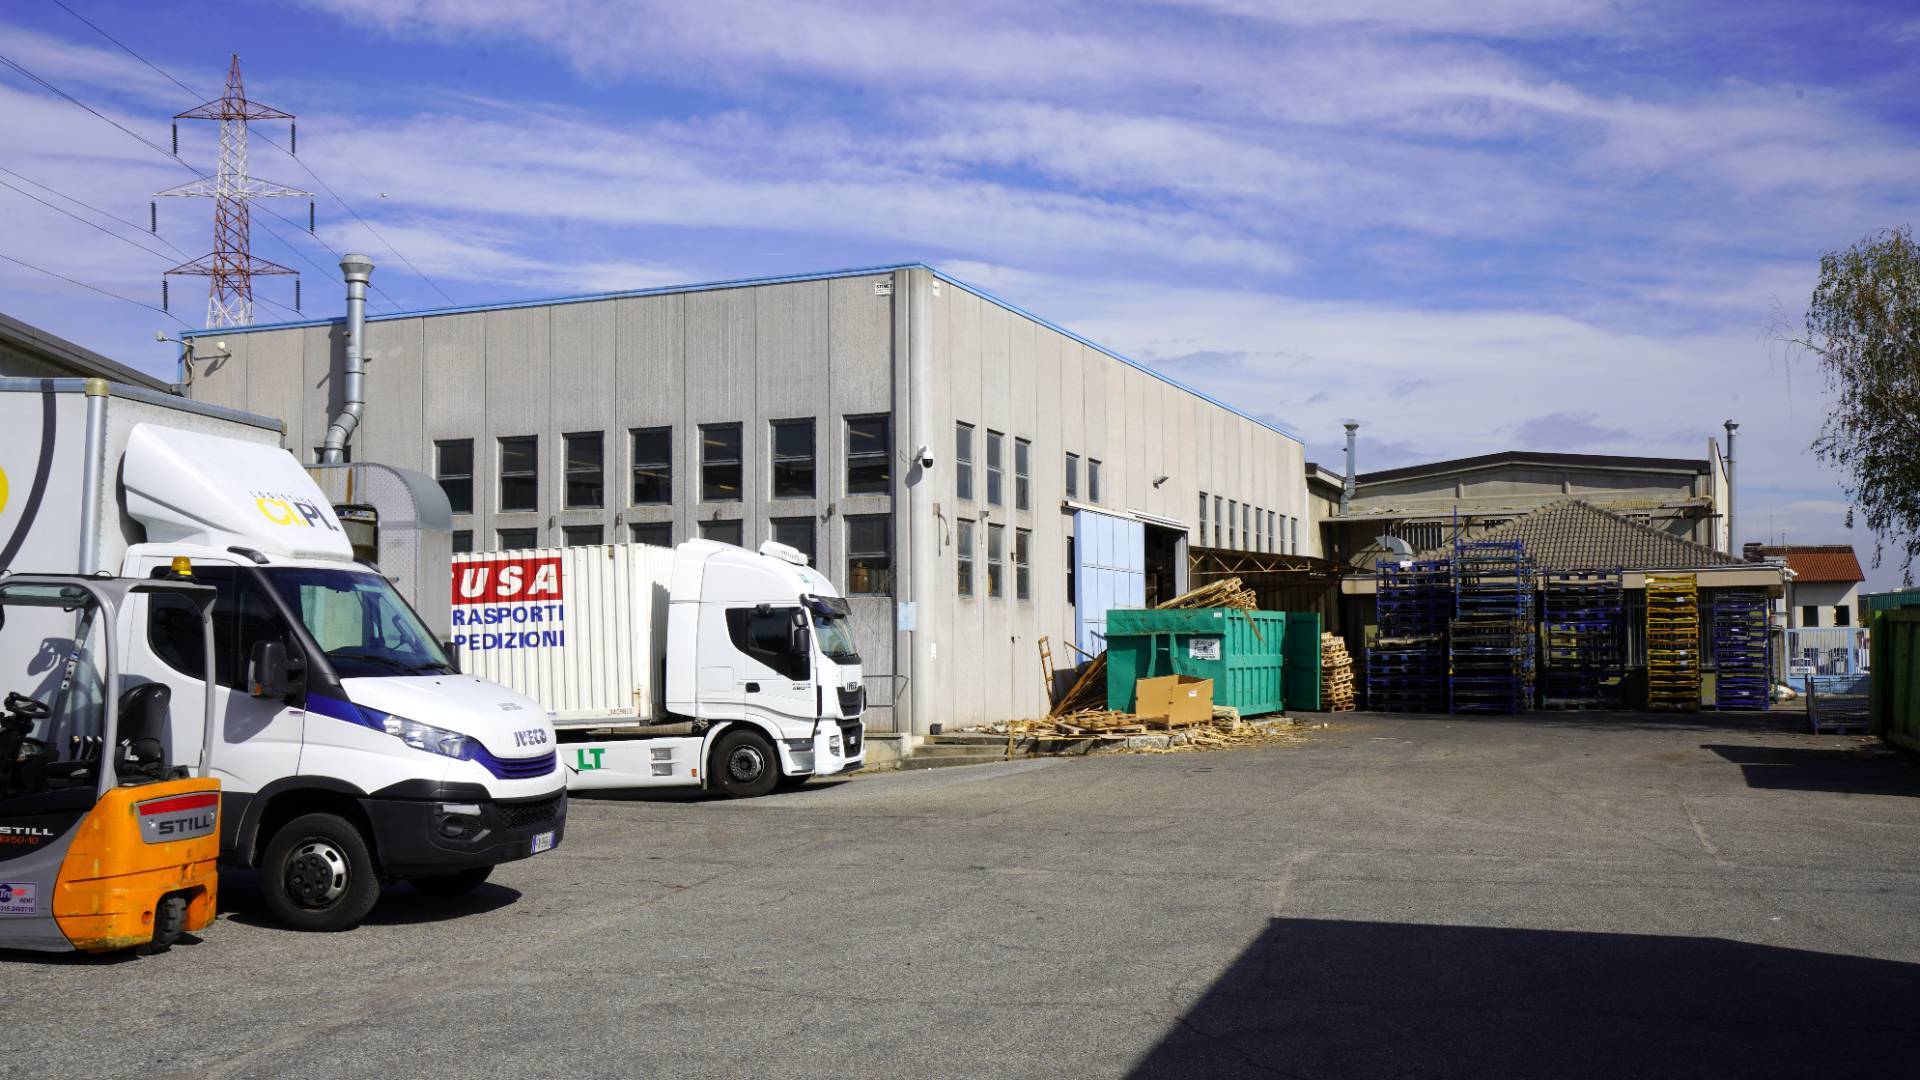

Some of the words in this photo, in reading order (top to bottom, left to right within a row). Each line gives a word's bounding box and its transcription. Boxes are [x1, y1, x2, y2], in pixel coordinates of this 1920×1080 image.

[451, 563, 559, 598] USA
[452, 604, 564, 626] RASPORTI
[453, 630, 565, 651] PEDIZIONI
[513, 728, 547, 748] IVECO
[0, 827, 54, 836] STILL
[158, 817, 210, 835] STILL
